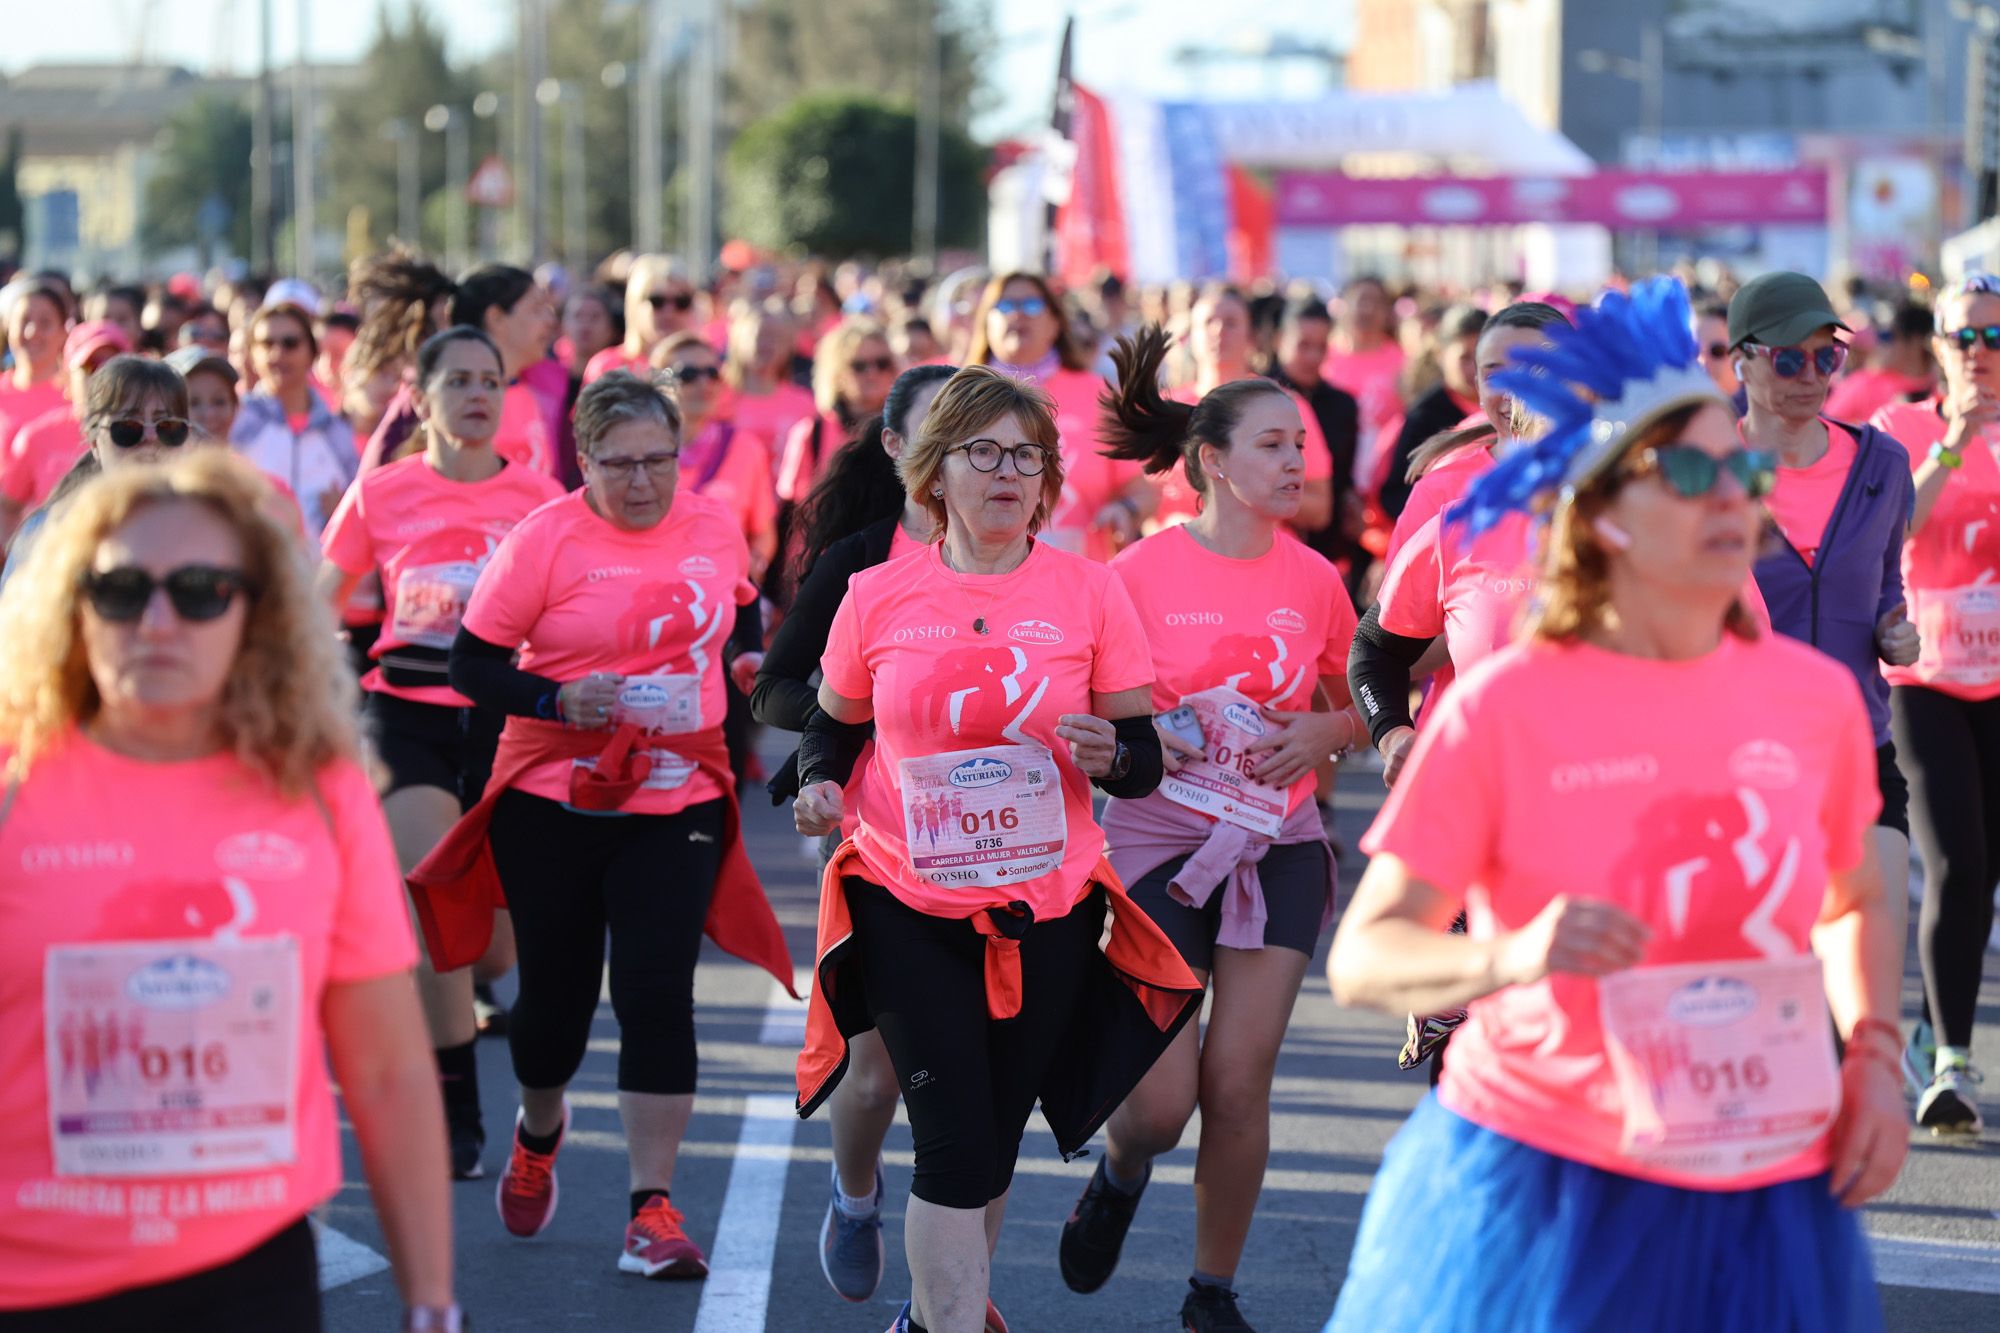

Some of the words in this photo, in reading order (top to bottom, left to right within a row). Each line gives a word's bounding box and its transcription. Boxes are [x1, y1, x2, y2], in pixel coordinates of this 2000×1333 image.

[1165, 611, 1223, 625] OYSHO
[894, 625, 956, 643] OYSHO
[1012, 628, 1060, 641] ASTURIANA
[1215, 747, 1255, 779] 016
[914, 780, 944, 790] SUMA
[954, 769, 1008, 783] ASTURIANA
[1168, 782, 1210, 804] OYSHO
[961, 807, 1018, 834] 016
[975, 838, 1003, 850] 8736
[931, 856, 963, 866] CARRERA
[965, 855, 975, 863] DE
[976, 853, 985, 861] LA
[987, 850, 1011, 860] MUJER
[1017, 845, 1049, 856] VALENCIA
[931, 870, 979, 882] OYSHO
[1008, 861, 1049, 876] Santander
[139, 1043, 228, 1084] 016
[1690, 1055, 1769, 1095] 016
